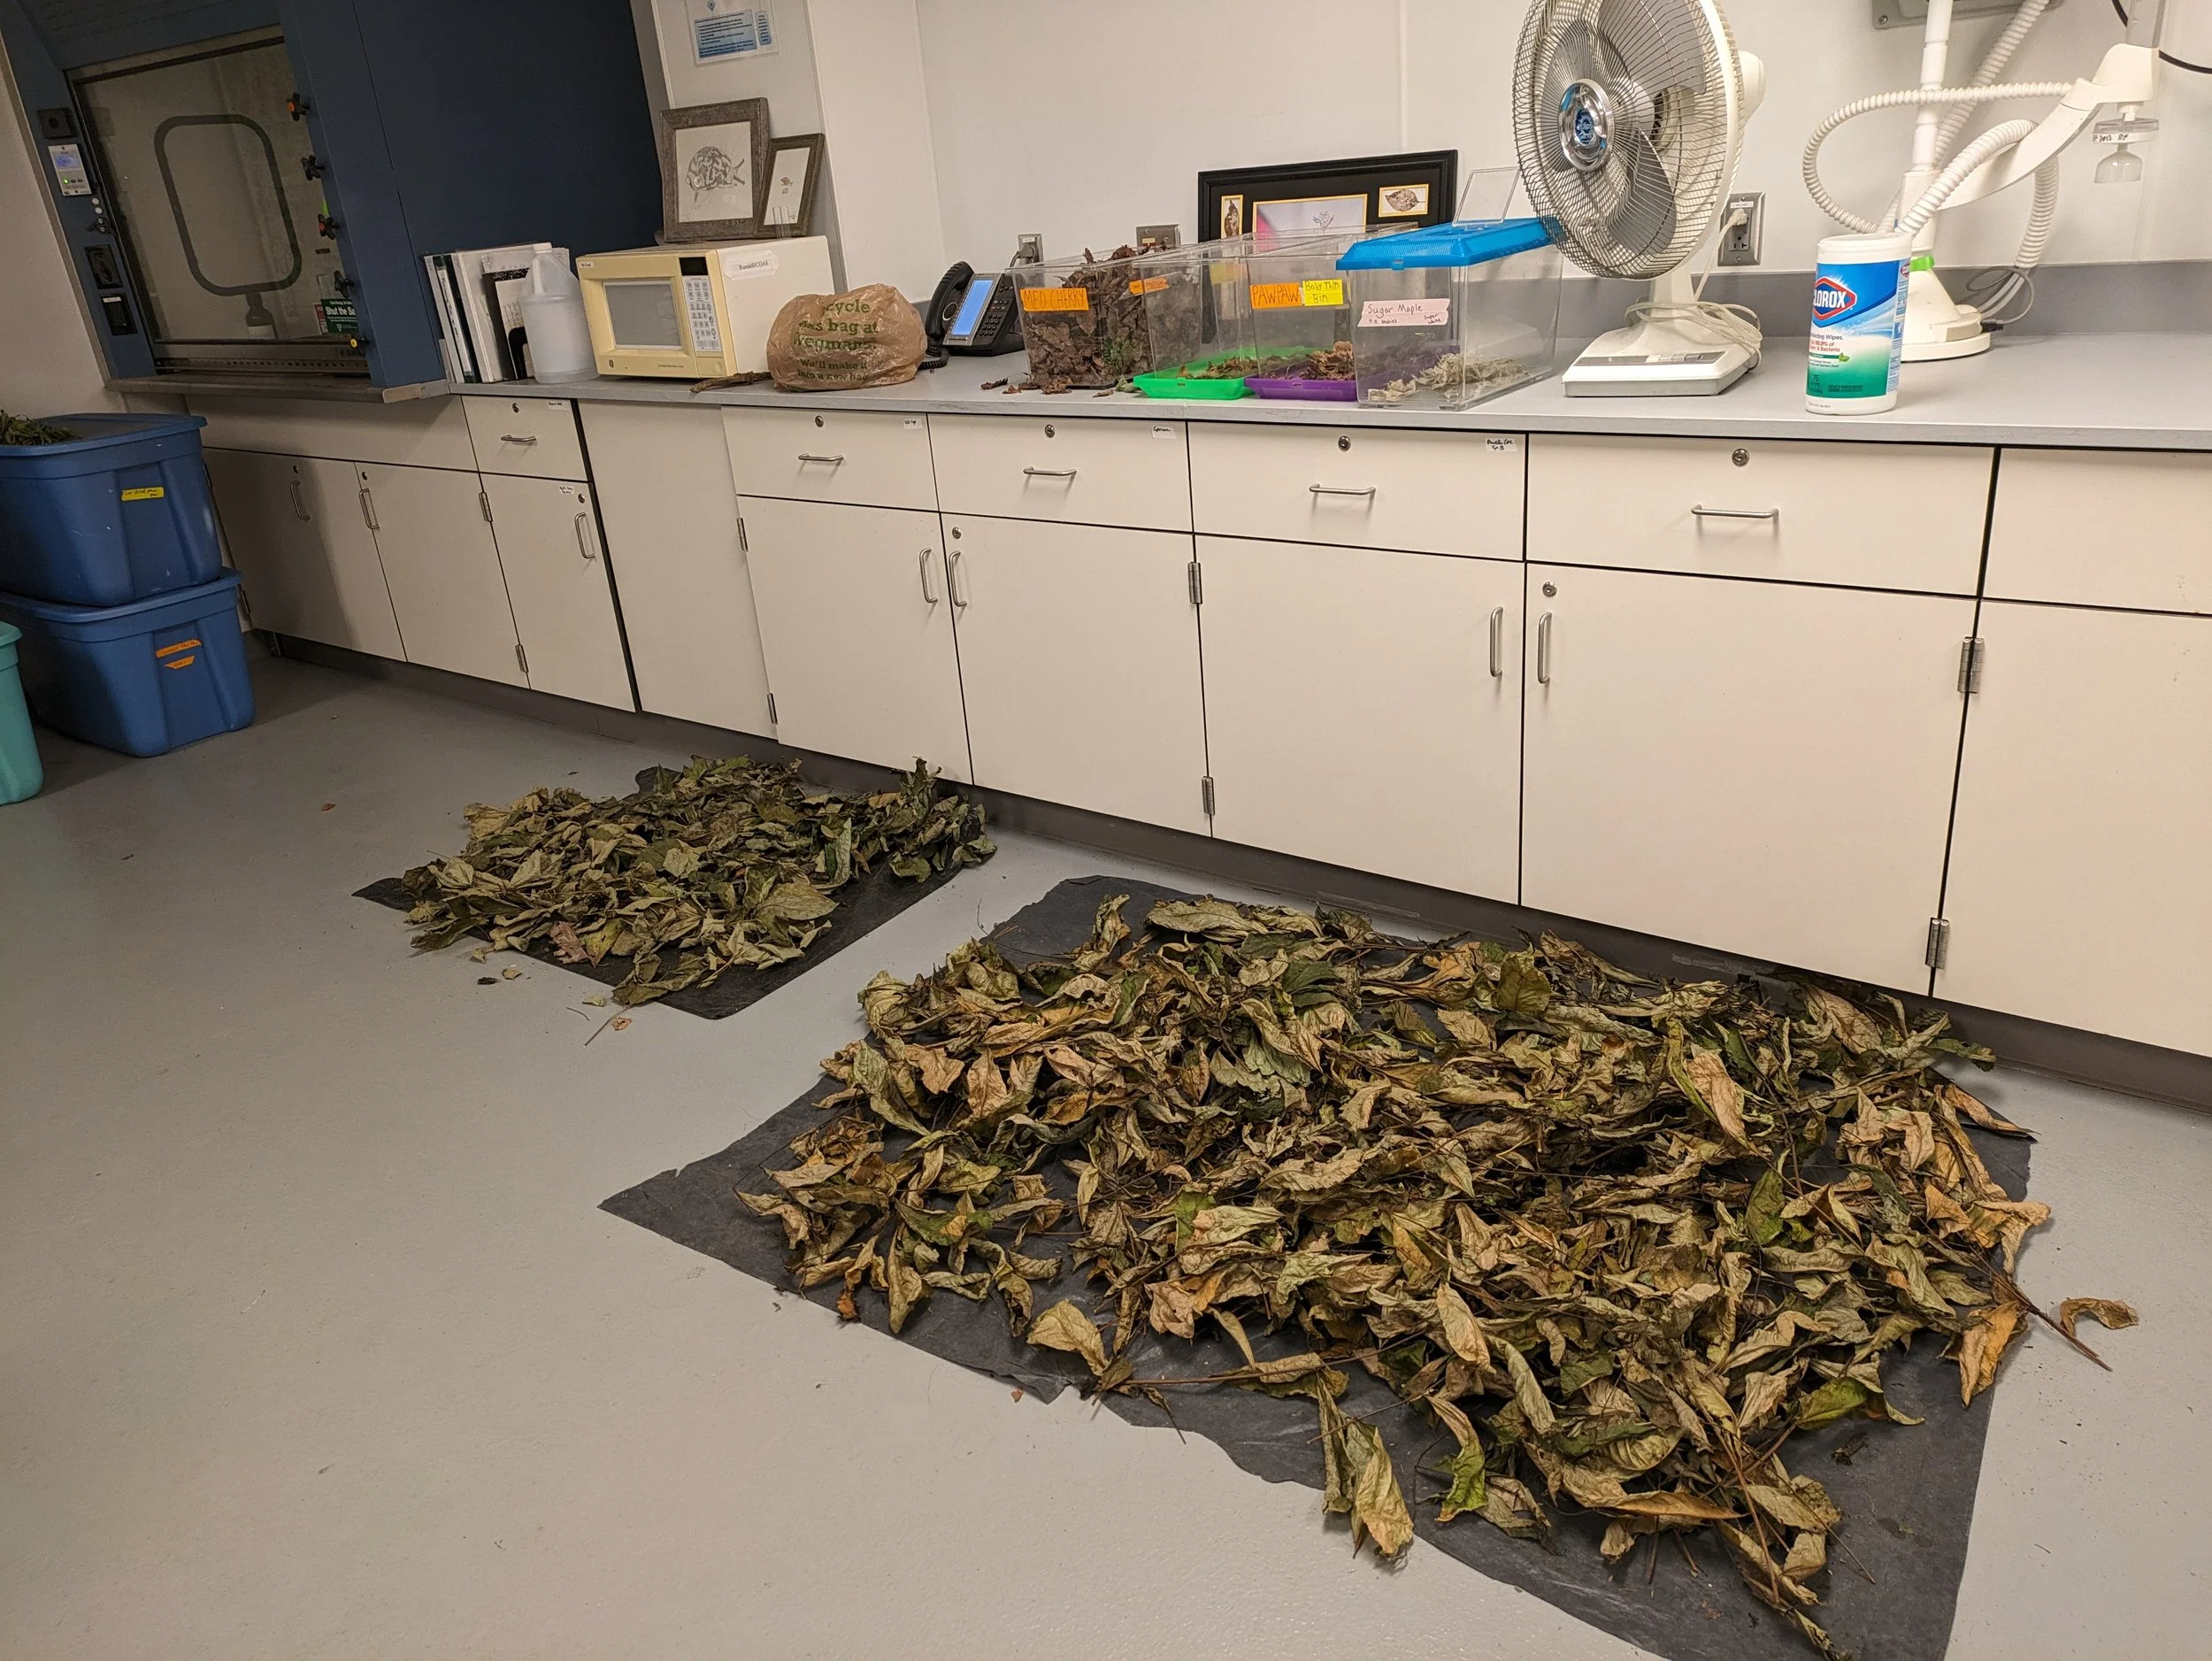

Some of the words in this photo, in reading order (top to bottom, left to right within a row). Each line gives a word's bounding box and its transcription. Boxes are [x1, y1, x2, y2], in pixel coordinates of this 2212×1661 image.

[1024, 290, 1047, 311] MED
[1049, 289, 1086, 310] CHERRY
[1252, 285, 1299, 306] PAWPAW
[1312, 293, 1328, 304] Bin
[325, 306, 339, 315] Shut
[822, 299, 871, 315] cycle
[1367, 304, 1394, 319] Sugar
[1397, 303, 1423, 315] Maple
[828, 318, 859, 335] bag
[799, 358, 827, 370] We'll
[828, 361, 859, 371] make
[797, 368, 816, 381] into
